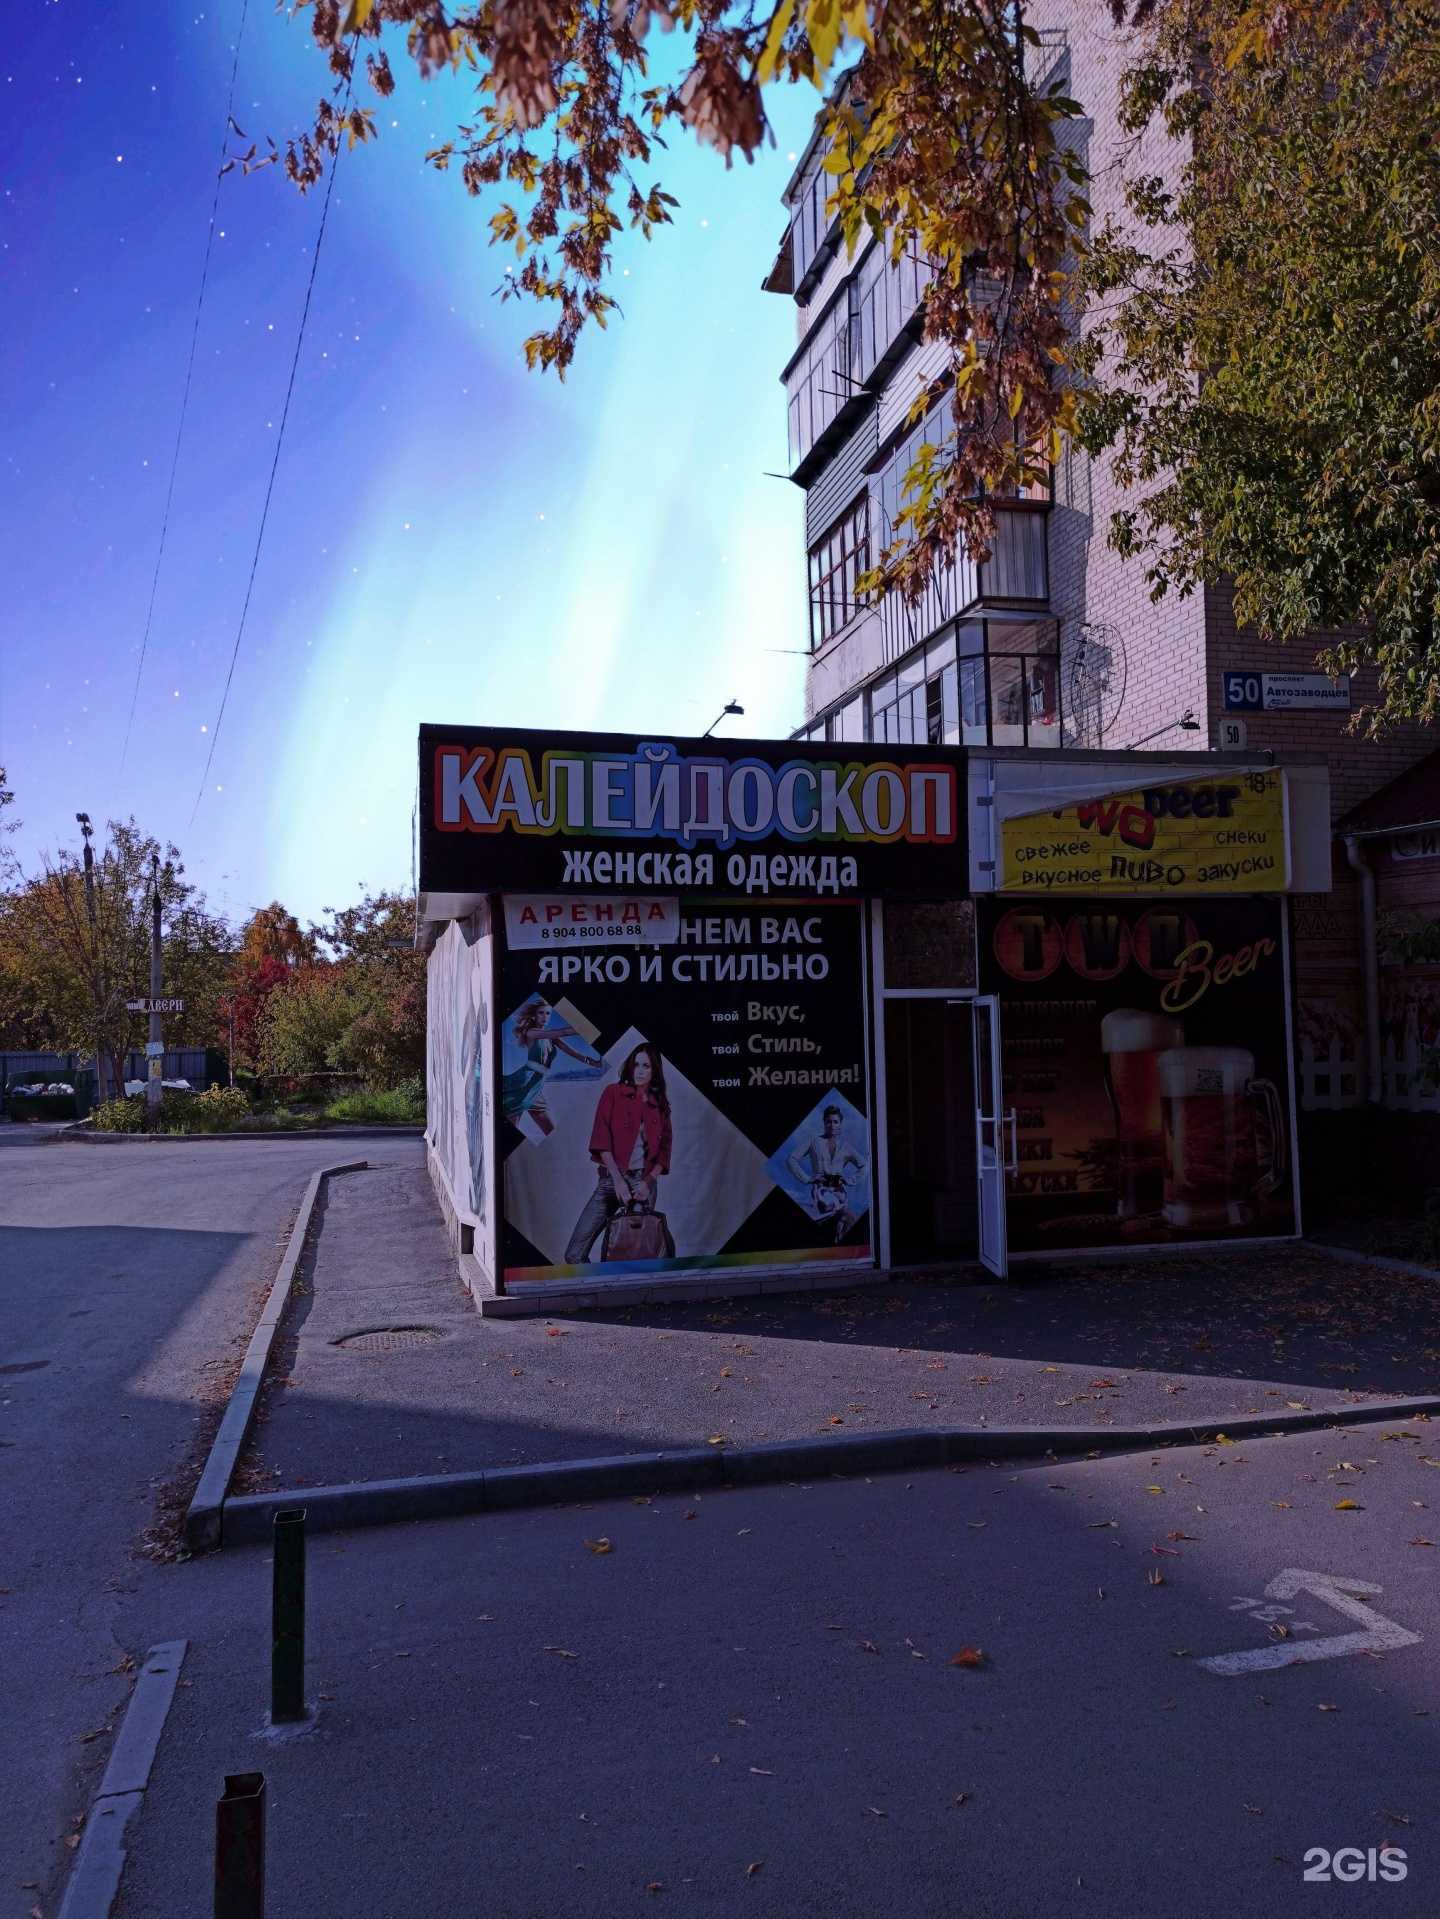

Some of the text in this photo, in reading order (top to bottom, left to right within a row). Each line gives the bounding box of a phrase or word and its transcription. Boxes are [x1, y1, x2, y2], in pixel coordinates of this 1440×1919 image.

[1228, 677, 1260, 703] 50
[1267, 686, 1348, 698] Автозаводцев
[1227, 726, 1240, 743] 50
[438, 746, 954, 842] КАЛЕЙДОСКОП
[1053, 800, 1155, 850] WO
[1216, 829, 1266, 845] снеки
[1015, 840, 1090, 863] свежее
[562, 850, 858, 894] женская одежда
[1022, 869, 1101, 890] вкусное
[1198, 854, 1275, 883] закуски
[520, 902, 665, 924] АРЕНДА
[542, 925, 641, 939] 8 904 800 68 88
[760, 917, 823, 944] ВАС
[538, 953, 830, 984] ЯРКО И СТИЛЬНО
[1160, 936, 1278, 1013] Beer
[711, 1001, 806, 1026] твой Вкус,
[711, 1034, 823, 1056] твой Стиль,
[747, 1064, 861, 1086] Желания!
